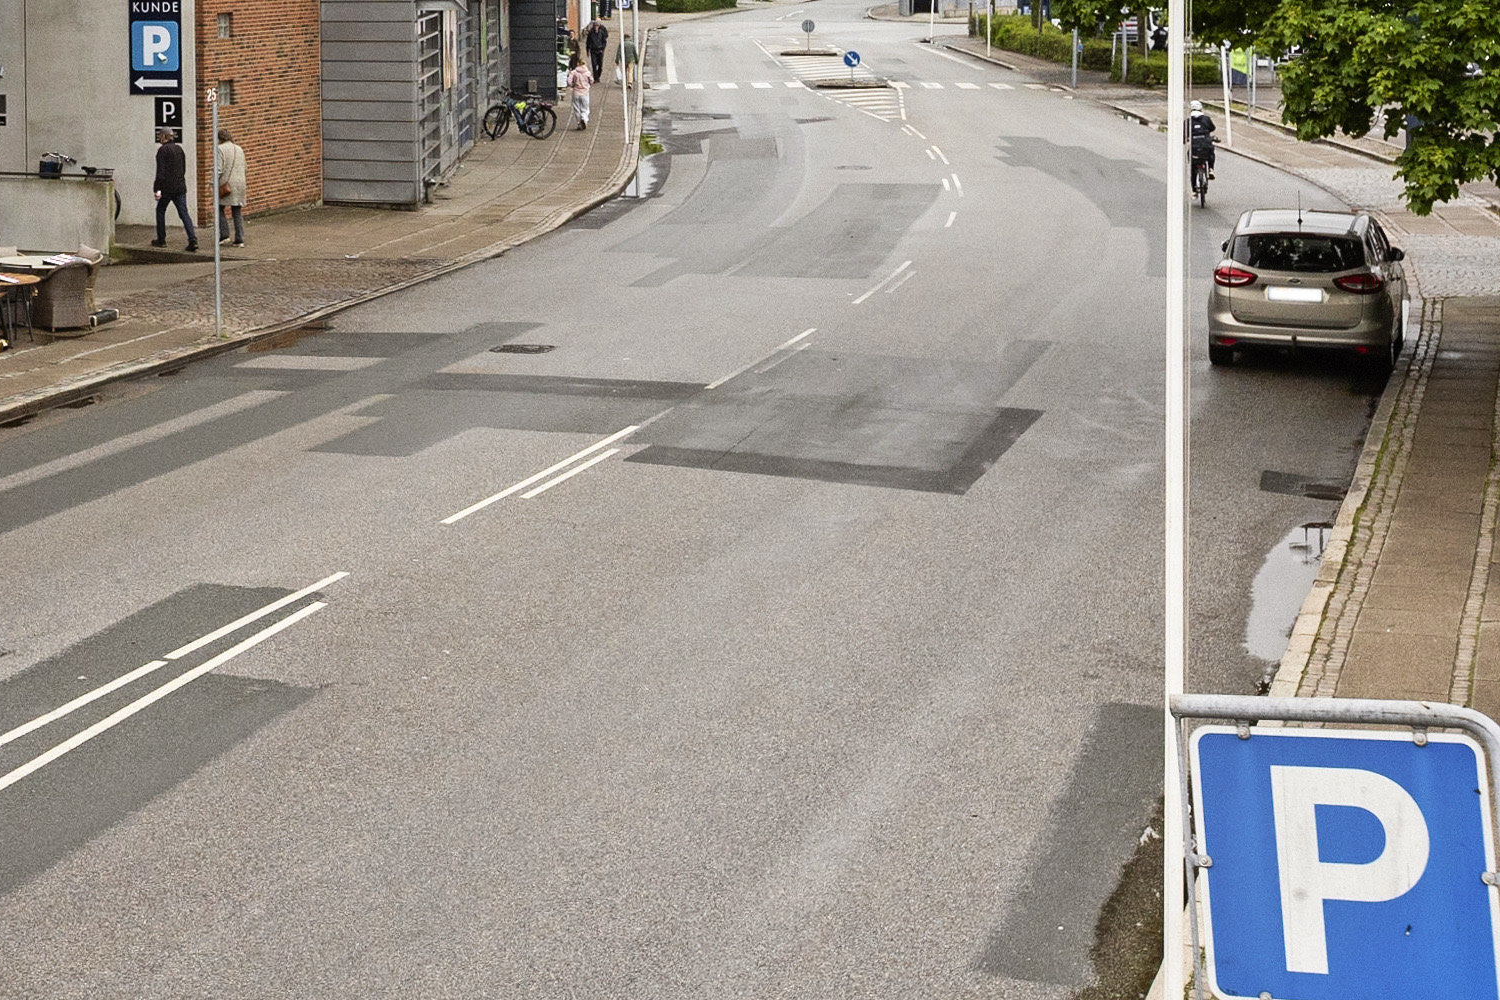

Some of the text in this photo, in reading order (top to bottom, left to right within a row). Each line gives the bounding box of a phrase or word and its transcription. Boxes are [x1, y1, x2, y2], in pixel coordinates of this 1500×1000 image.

[132, 1, 179, 13] KUNDE
[142, 25, 171, 66] P
[206, 87, 218, 102] 25
[163, 101, 175, 123] P
[1270, 765, 1430, 974] P
